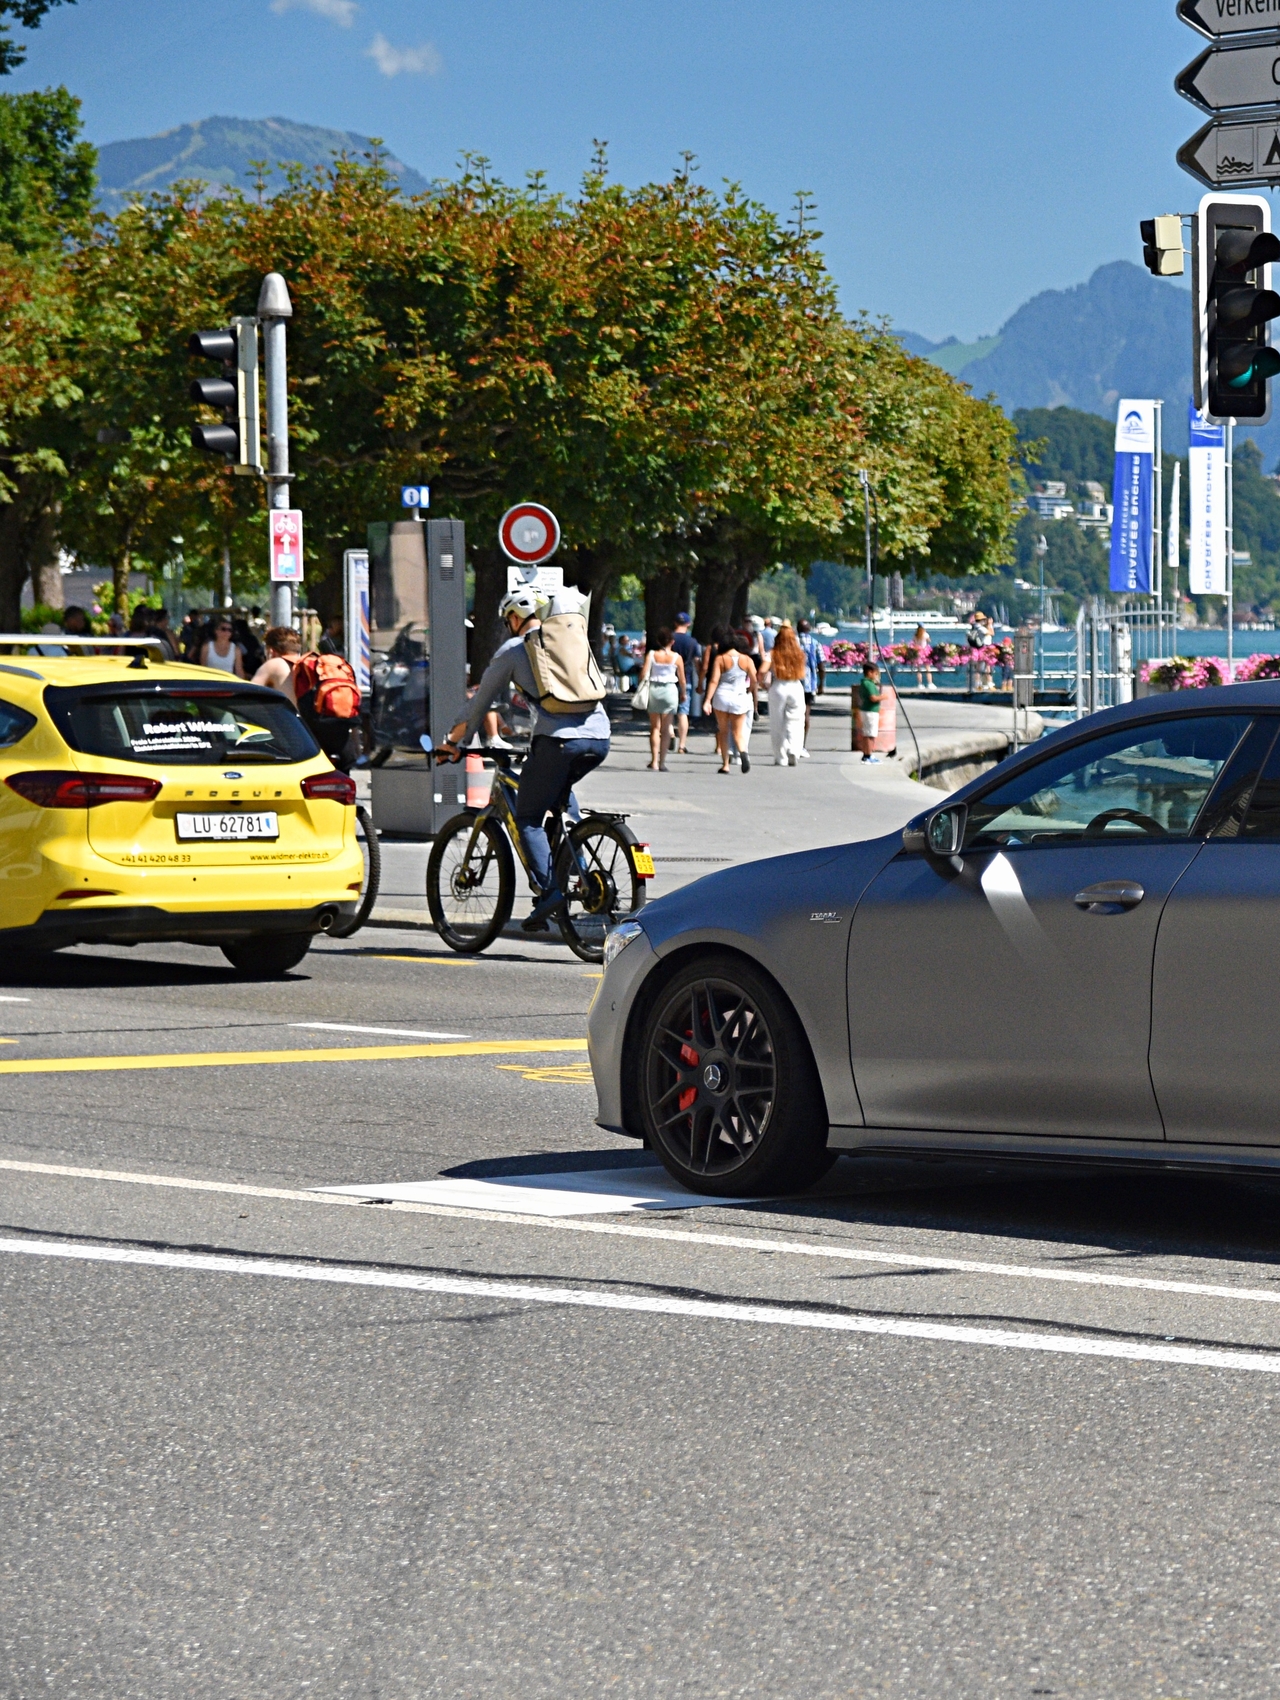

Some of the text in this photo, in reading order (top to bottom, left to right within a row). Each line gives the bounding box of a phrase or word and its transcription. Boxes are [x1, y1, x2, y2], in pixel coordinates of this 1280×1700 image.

[138, 855, 148, 863] 41
[150, 854, 166, 863] 420
[168, 854, 179, 863] 48
[181, 854, 191, 862] 33
